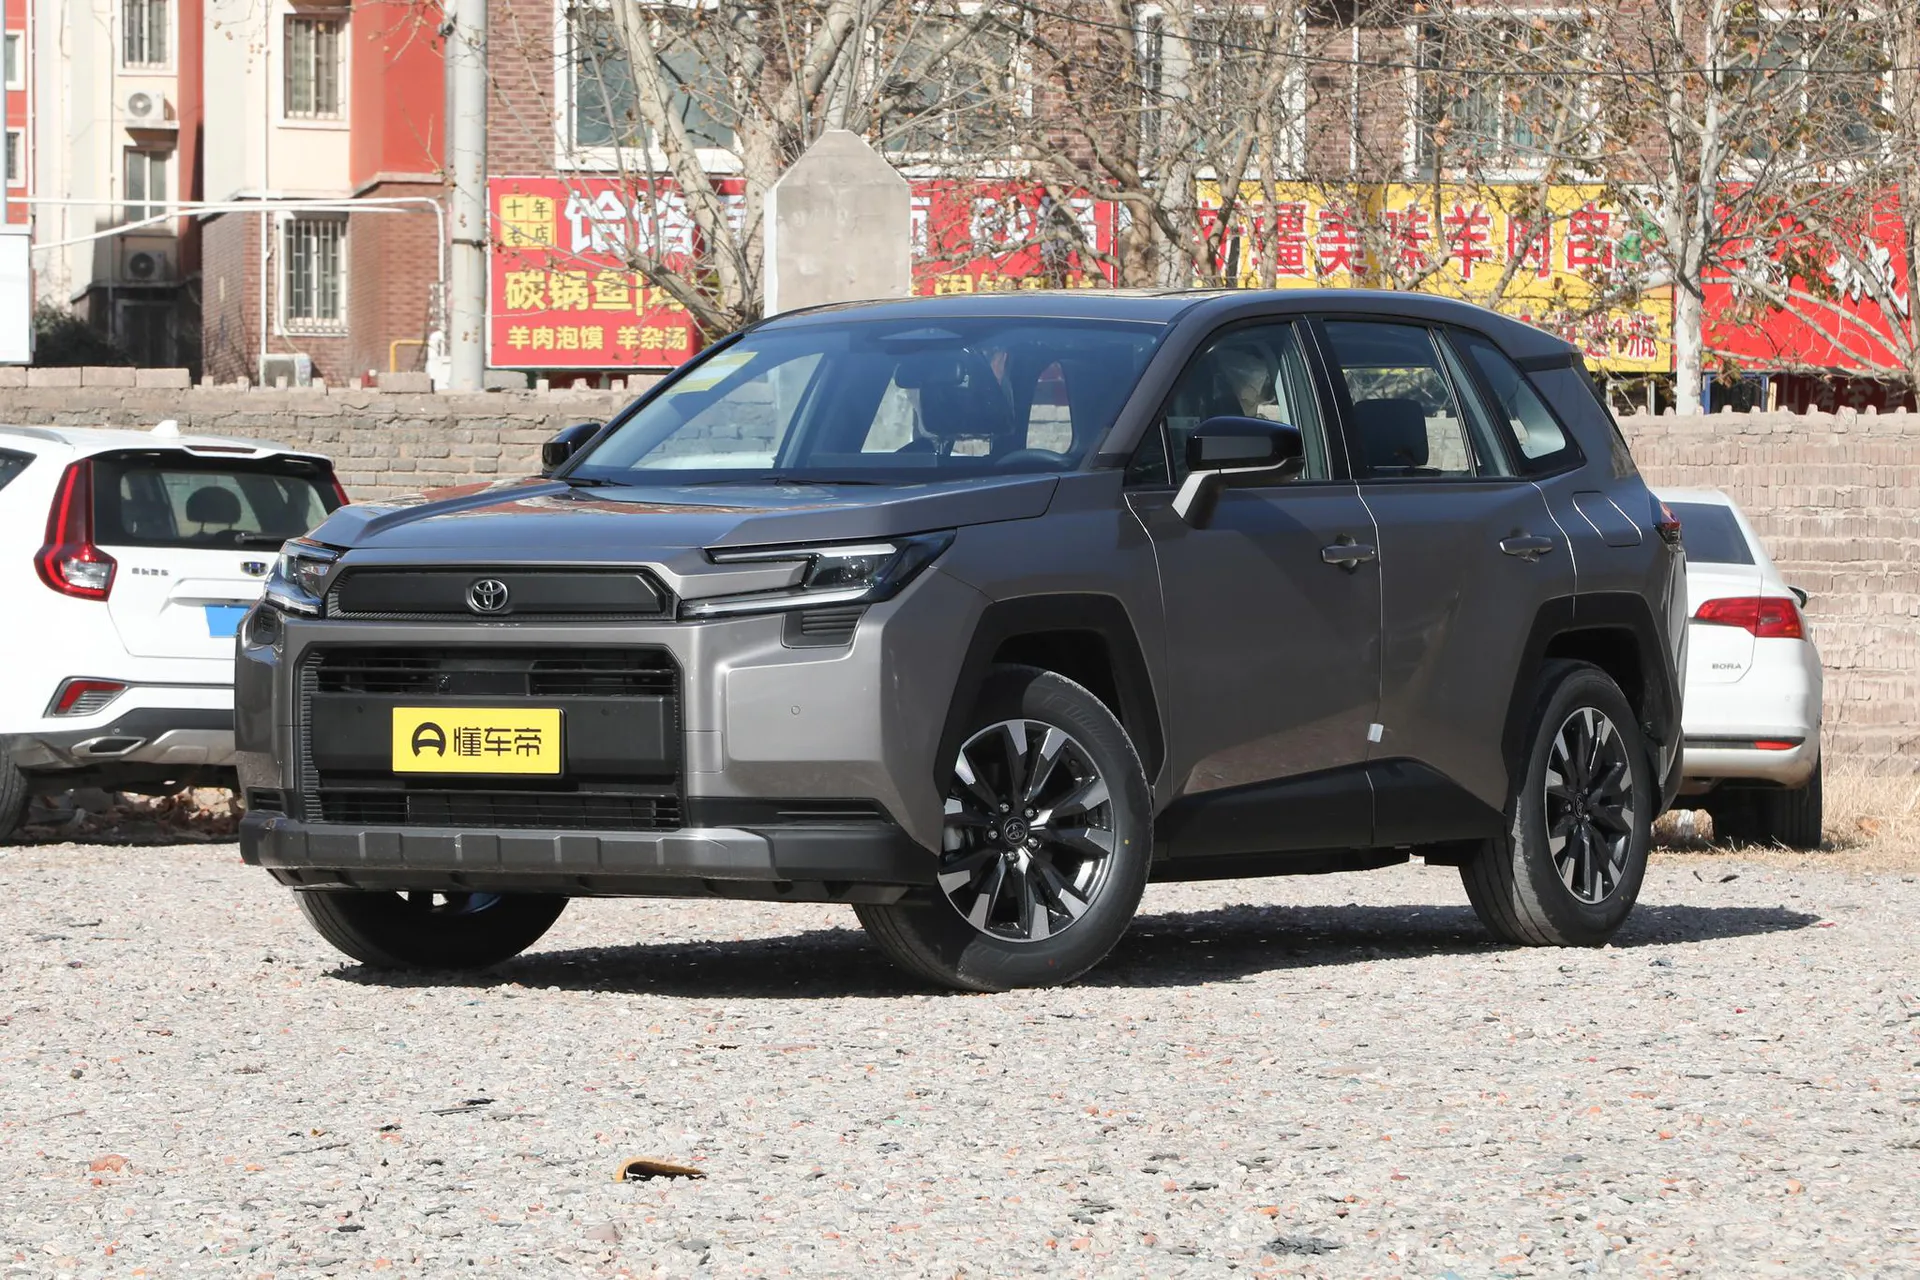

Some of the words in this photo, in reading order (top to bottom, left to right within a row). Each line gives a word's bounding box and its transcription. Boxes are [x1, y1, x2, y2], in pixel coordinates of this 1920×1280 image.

[506, 199, 550, 219] 十年
[564, 190, 747, 254] 饸饹
[508, 326, 604, 350] 羊肉泡馍
[616, 326, 688, 350] 羊杂汤
[1711, 662, 1742, 670] BORA
[453, 726, 542, 757] 懂车帝
